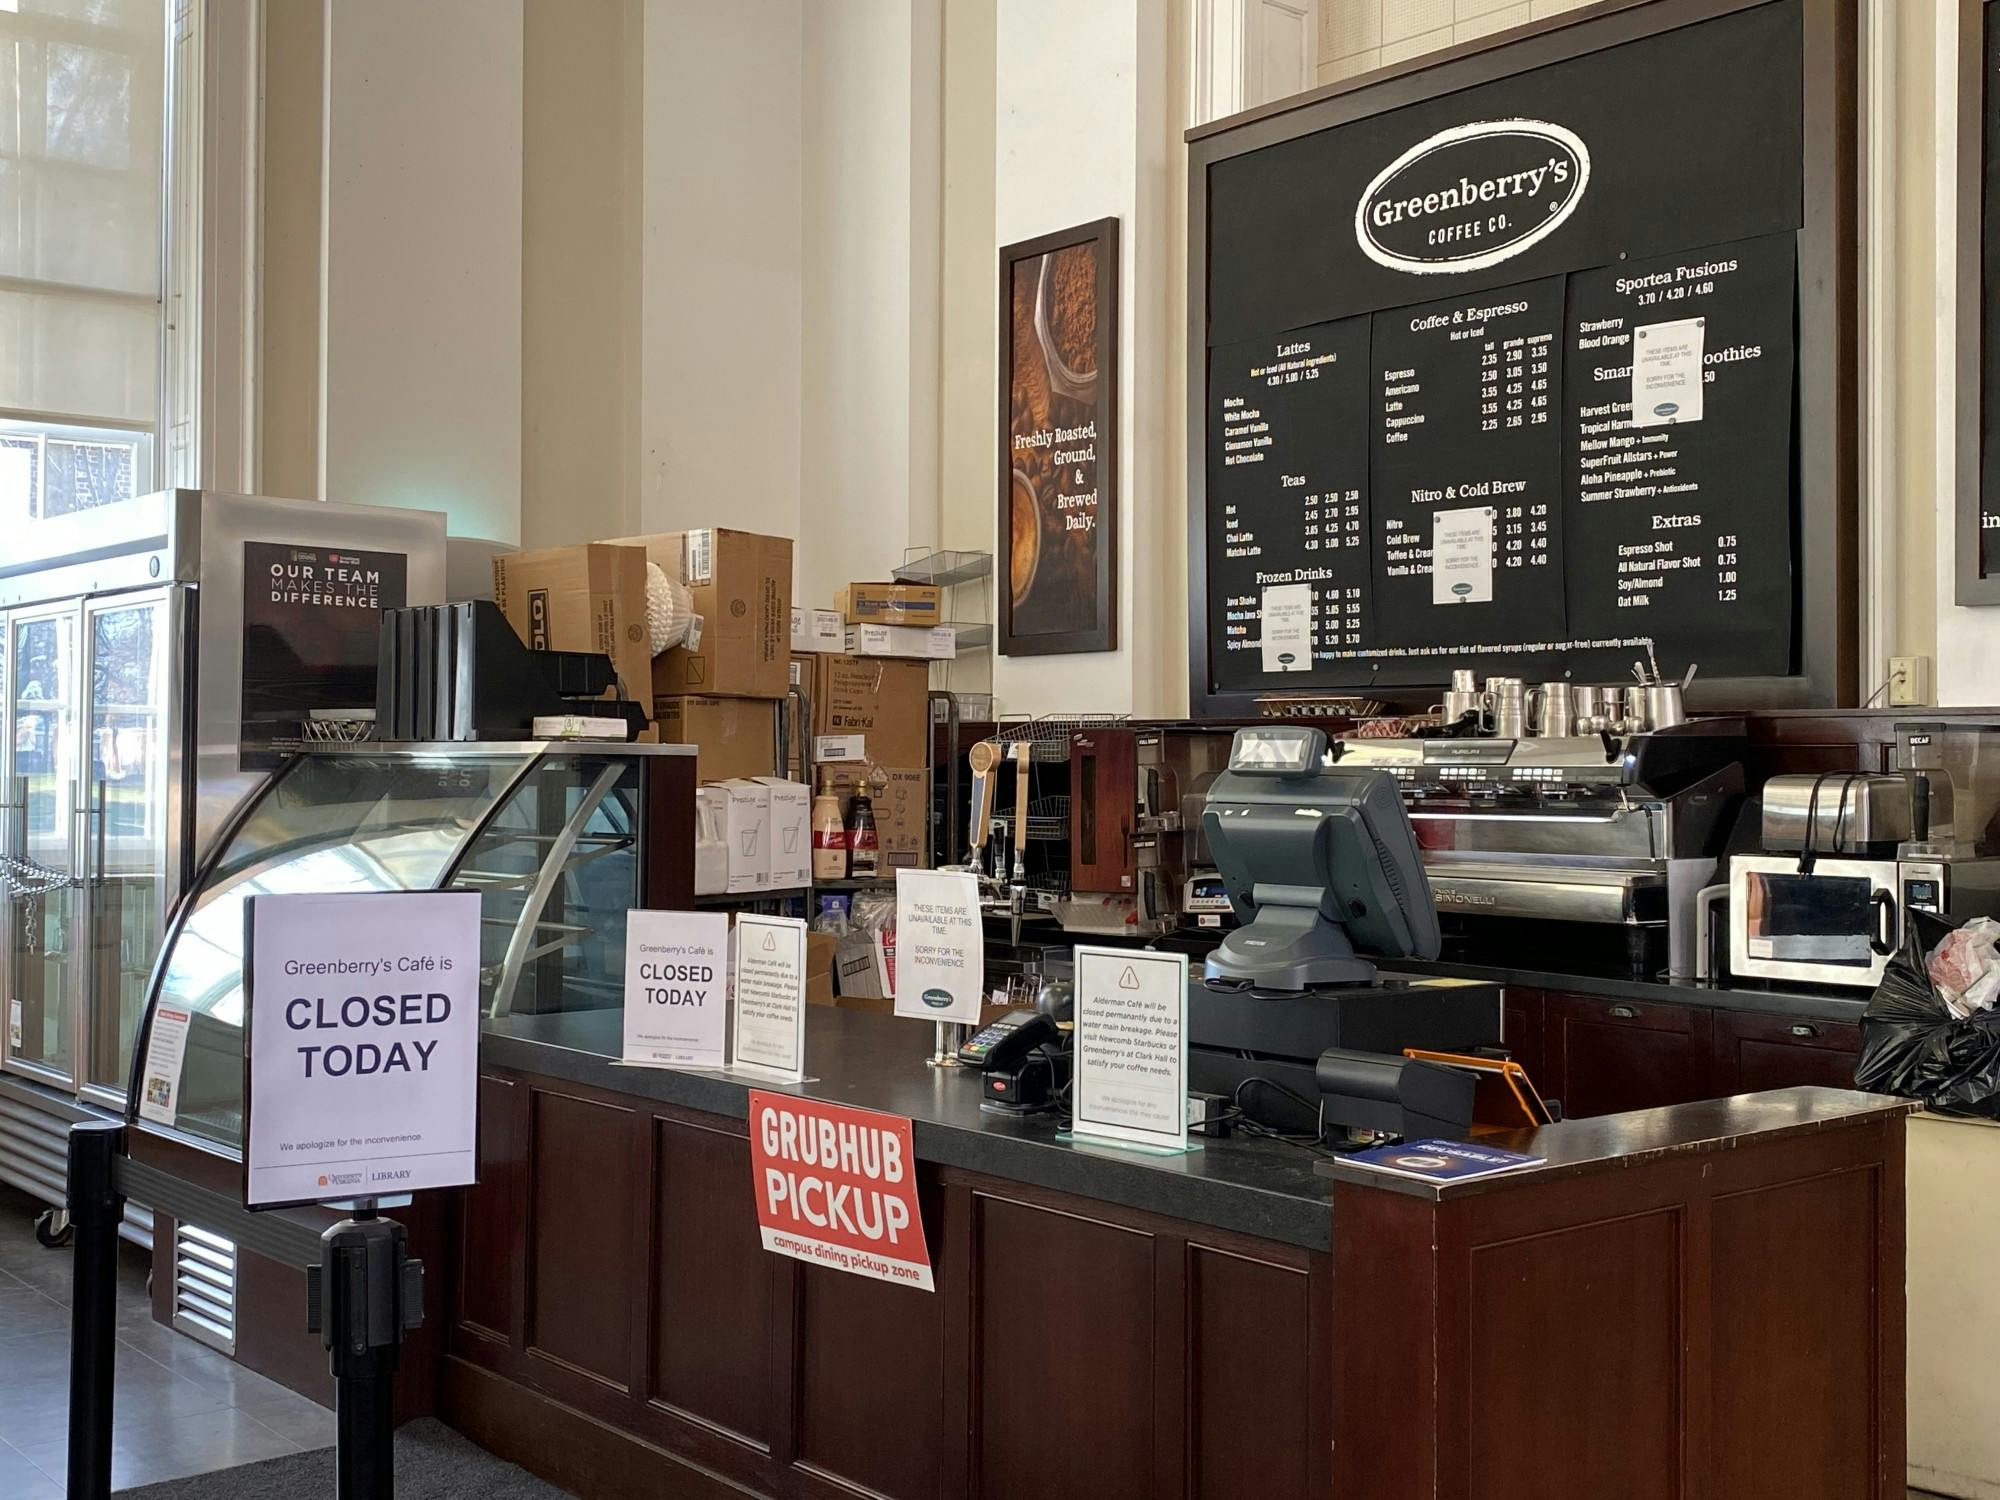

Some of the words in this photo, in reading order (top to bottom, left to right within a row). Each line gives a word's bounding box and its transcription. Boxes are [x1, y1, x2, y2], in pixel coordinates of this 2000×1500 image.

[1373, 158, 1568, 226] Greenberry's
[1428, 220, 1481, 245] COFFEE
[1488, 214, 1512, 232] CO.
[1615, 271, 1672, 294] Sportea
[1675, 259, 1738, 281] Fusions
[1638, 292, 1656, 306] 3.70
[1666, 287, 1684, 300] 4.20
[1695, 281, 1714, 295] 4.60
[1410, 315, 1449, 331] Coffee
[1452, 311, 1463, 323] &
[1466, 301, 1528, 322] Espresso
[1580, 318, 1624, 333] Strawberry
[1450, 331, 1461, 341] Hot
[1462, 331, 1469, 339] or
[1470, 326, 1484, 337] Iced
[1579, 335, 1600, 349] Blood
[1602, 333, 1630, 347] Orange
[1277, 342, 1310, 357] Lattes
[1384, 369, 1415, 381] Espresso
[1481, 353, 1498, 366] 2.35
[1506, 349, 1522, 361] 2.90
[1531, 345, 1547, 358] 3.35
[1593, 365, 1633, 381] Smar
[1702, 345, 1761, 365] oothies
[1385, 384, 1420, 397] Americano
[1481, 370, 1498, 382] 2.50
[1506, 366, 1522, 378] 3.05
[1531, 362, 1547, 374] 3.50
[1385, 401, 1403, 412] Latte
[1481, 386, 1498, 398] 3.55
[1506, 382, 1522, 394] 4.25
[1531, 378, 1547, 390] 4.65
[1385, 414, 1425, 429] Cappuccino
[1481, 402, 1498, 414] 3.55
[1506, 399, 1522, 411] 4.25
[1531, 395, 1547, 407] 4.65
[1580, 402, 1610, 417] Harvest
[1015, 429, 1053, 449] Freshly
[1054, 421, 1097, 443] Roasted,
[1386, 432, 1408, 443] Coffee
[1481, 419, 1498, 431] 2.25
[1506, 415, 1522, 427] 2.65
[1531, 411, 1547, 424] 2.95
[1580, 420, 1610, 434] Tropical
[1580, 438, 1608, 451] Mellow
[1609, 435, 1635, 449] Mango
[1054, 444, 1096, 465] Ground,
[1580, 454, 1621, 469] SuperFruit
[1622, 450, 1653, 463] Allstars
[1075, 469, 1084, 485] &
[1281, 475, 1305, 487] Teas
[1580, 473, 1603, 485] Aloha
[1604, 469, 1643, 484] Pineapple
[1057, 488, 1097, 509] Brewed
[1411, 489, 1442, 503] Nitro
[1445, 486, 1456, 499] &
[1459, 482, 1489, 498] Cold
[1492, 480, 1526, 494] Brew
[1580, 489, 1613, 502] Summer
[1614, 484, 1656, 499] Strawberry
[1065, 512, 1096, 531] Daily.
[1386, 520, 1403, 530] Nitro
[1651, 514, 1701, 530] Extras
[1386, 534, 1401, 545] Cold
[1402, 533, 1420, 544] Brew
[1618, 543, 1653, 557] Espresso
[1654, 540, 1673, 553] Shot
[1717, 535, 1736, 547] 0.75
[1617, 561, 1628, 573] All
[1628, 559, 1656, 571] Natural
[1656, 558, 1681, 570] Flavor
[1682, 556, 1701, 568] Shot
[1717, 553, 1736, 565] 0.75
[270, 563, 313, 579] OUR
[325, 567, 379, 584] TEAM
[1256, 572, 1292, 584] Frozen
[1294, 567, 1332, 580] Drinks
[1617, 576, 1663, 591] Soy/Almond
[1718, 571, 1736, 583] 1.00
[271, 578, 335, 594] MAKES
[344, 583, 378, 597] THE
[271, 591, 378, 608] DIFFERENCE
[1617, 595, 1632, 608] Oat
[1632, 594, 1650, 606] Milk
[1718, 589, 1736, 601] 1.25
[1909, 736, 1930, 745] DECAF
[1435, 894, 1495, 905] SIMONELLI
[914, 904, 934, 913] THESE
[935, 905, 954, 915] ITEMS
[954, 907, 967, 916] ARE
[909, 914, 949, 925] UNAVAILABLE
[949, 917, 957, 926] AT
[957, 917, 972, 927] THIS
[639, 944, 687, 956] Greenberry's
[688, 945, 706, 955] Café
[914, 945, 937, 955] SORRY
[938, 947, 951, 956] FOR
[951, 948, 965, 958] THE
[284, 958, 392, 976] Greenberry's
[397, 955, 435, 972] Café
[439, 956, 453, 970] is
[914, 956, 965, 968] INCONVENIENCE
[640, 963, 713, 982] CLOSED
[645, 987, 707, 1007] TODAY
[1093, 996, 1125, 1006] Alderman
[1126, 999, 1143, 1008] Café
[1144, 1001, 1156, 1010] will
[1157, 1002, 1167, 1011] be
[285, 993, 451, 1031] CLOSED
[1083, 1008, 1104, 1017] closed
[1149, 1014, 1162, 1023] due
[1163, 1016, 1171, 1024] to
[1083, 1021, 1101, 1029] water
[1102, 1022, 1119, 1030] main
[1120, 1024, 1153, 1036] breakage.
[1154, 1028, 1178, 1038] Please
[1083, 1033, 1097, 1041] visit
[1099, 1035, 1131, 1045] Newcomb
[1133, 1038, 1167, 1050] Starbucks
[297, 1040, 438, 1078] TODAY
[1083, 1045, 1125, 1057] Greenberry's
[1126, 1050, 1134, 1058] at
[1135, 1050, 1152, 1060] Clark
[1154, 1054, 1168, 1063] Hall
[1169, 1056, 1177, 1064] to
[1087, 1058, 1109, 1069] satisfy
[1110, 1062, 1126, 1070] your
[1126, 1064, 1149, 1073] coffee
[1149, 1066, 1172, 1076] needs.
[280, 1142, 294, 1151] We
[296, 1139, 335, 1152] apologize
[337, 1138, 348, 1147] for
[349, 1137, 363, 1146] the
[761, 1107, 904, 1184] GRUBHUB
[372, 1169, 411, 1181] LIBRARY
[765, 1168, 910, 1245] PICKUP
[774, 1235, 812, 1255] campus
[815, 1244, 849, 1267] dining
[851, 1254, 889, 1277] pickup
[891, 1265, 920, 1281] zone
